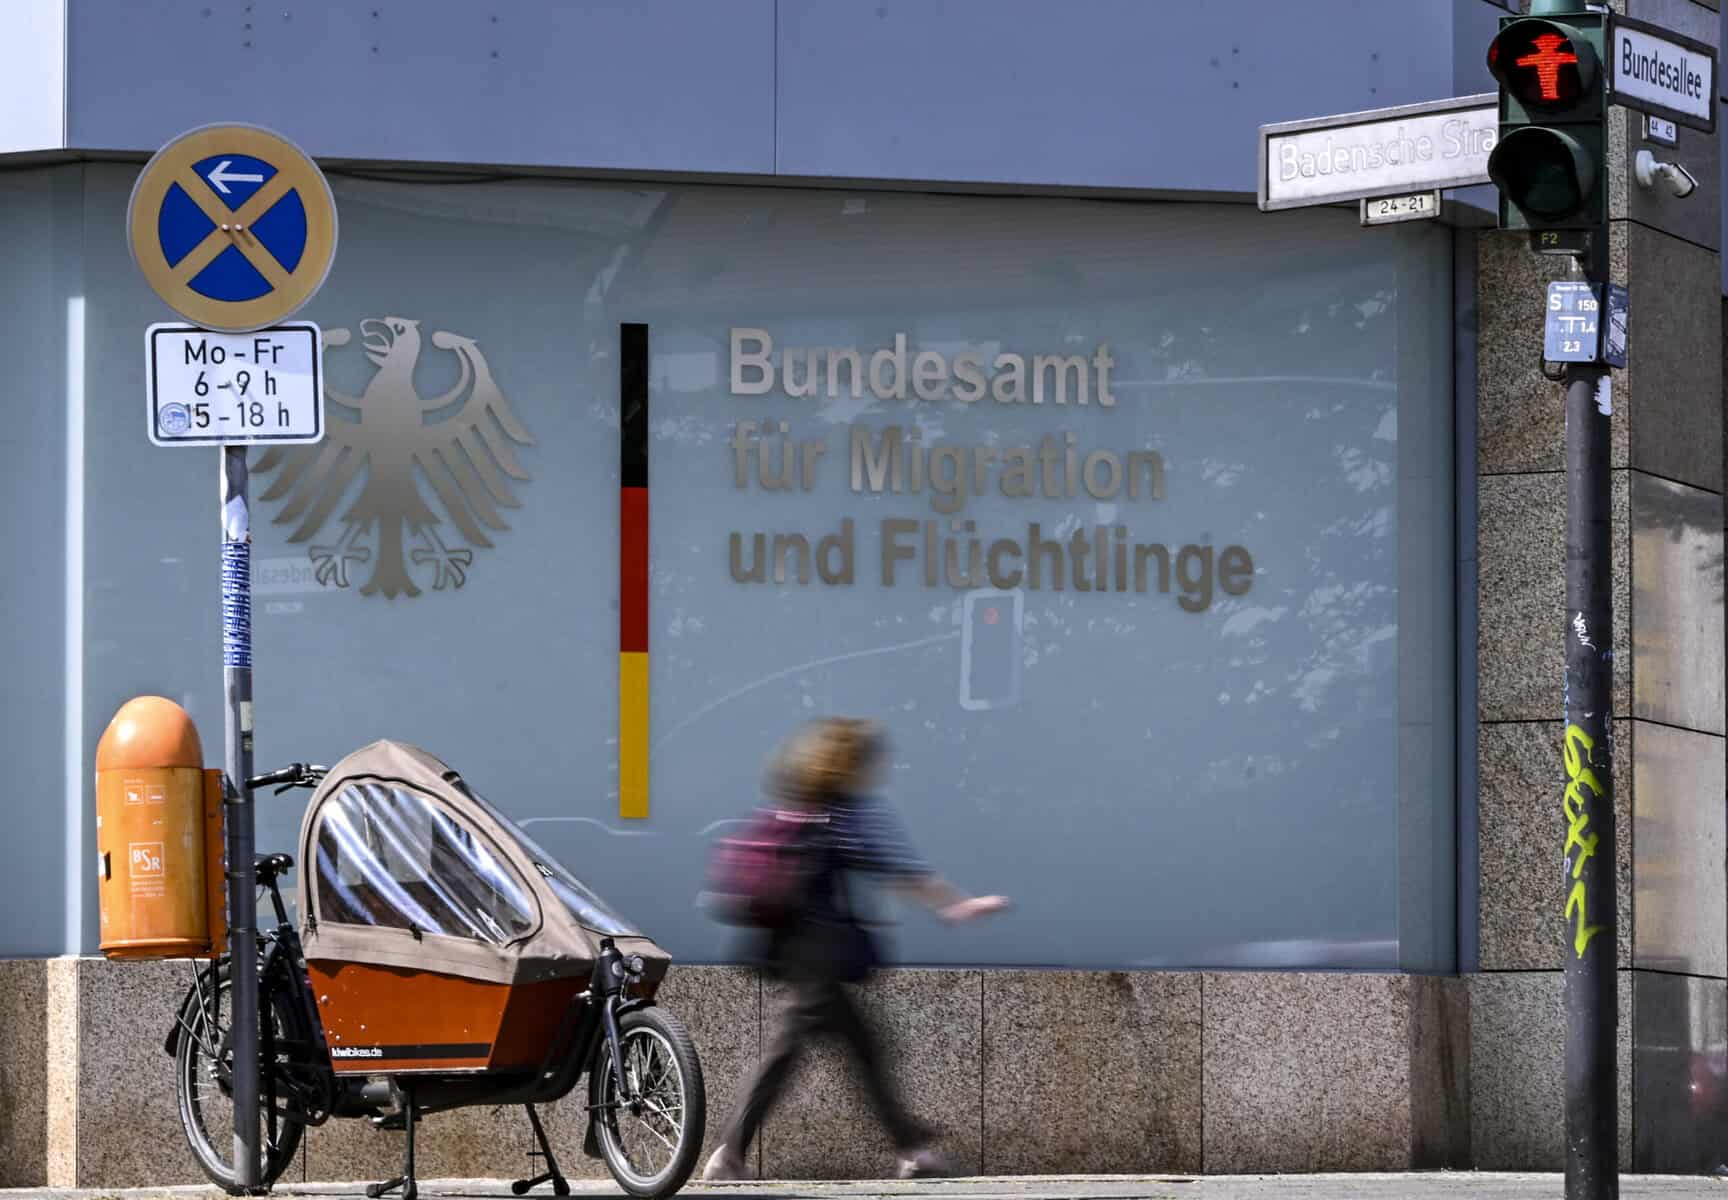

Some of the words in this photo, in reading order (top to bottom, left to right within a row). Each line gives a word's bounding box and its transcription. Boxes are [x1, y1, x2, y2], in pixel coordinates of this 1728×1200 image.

[1622, 38, 1701, 99] Bundesallee
[1279, 126, 1433, 182] Badensche
[1541, 232, 1558, 244] F2
[1550, 293, 1562, 311] S
[1577, 299, 1598, 311] 150
[265, 370, 277, 396] h
[729, 327, 1116, 406] Bundesamt
[278, 402, 290, 427] h
[732, 421, 825, 490] für
[849, 424, 1167, 513] Migration
[728, 518, 855, 586] und
[880, 518, 1254, 613] Flüchtlinge
[132, 849, 161, 871] BSR
